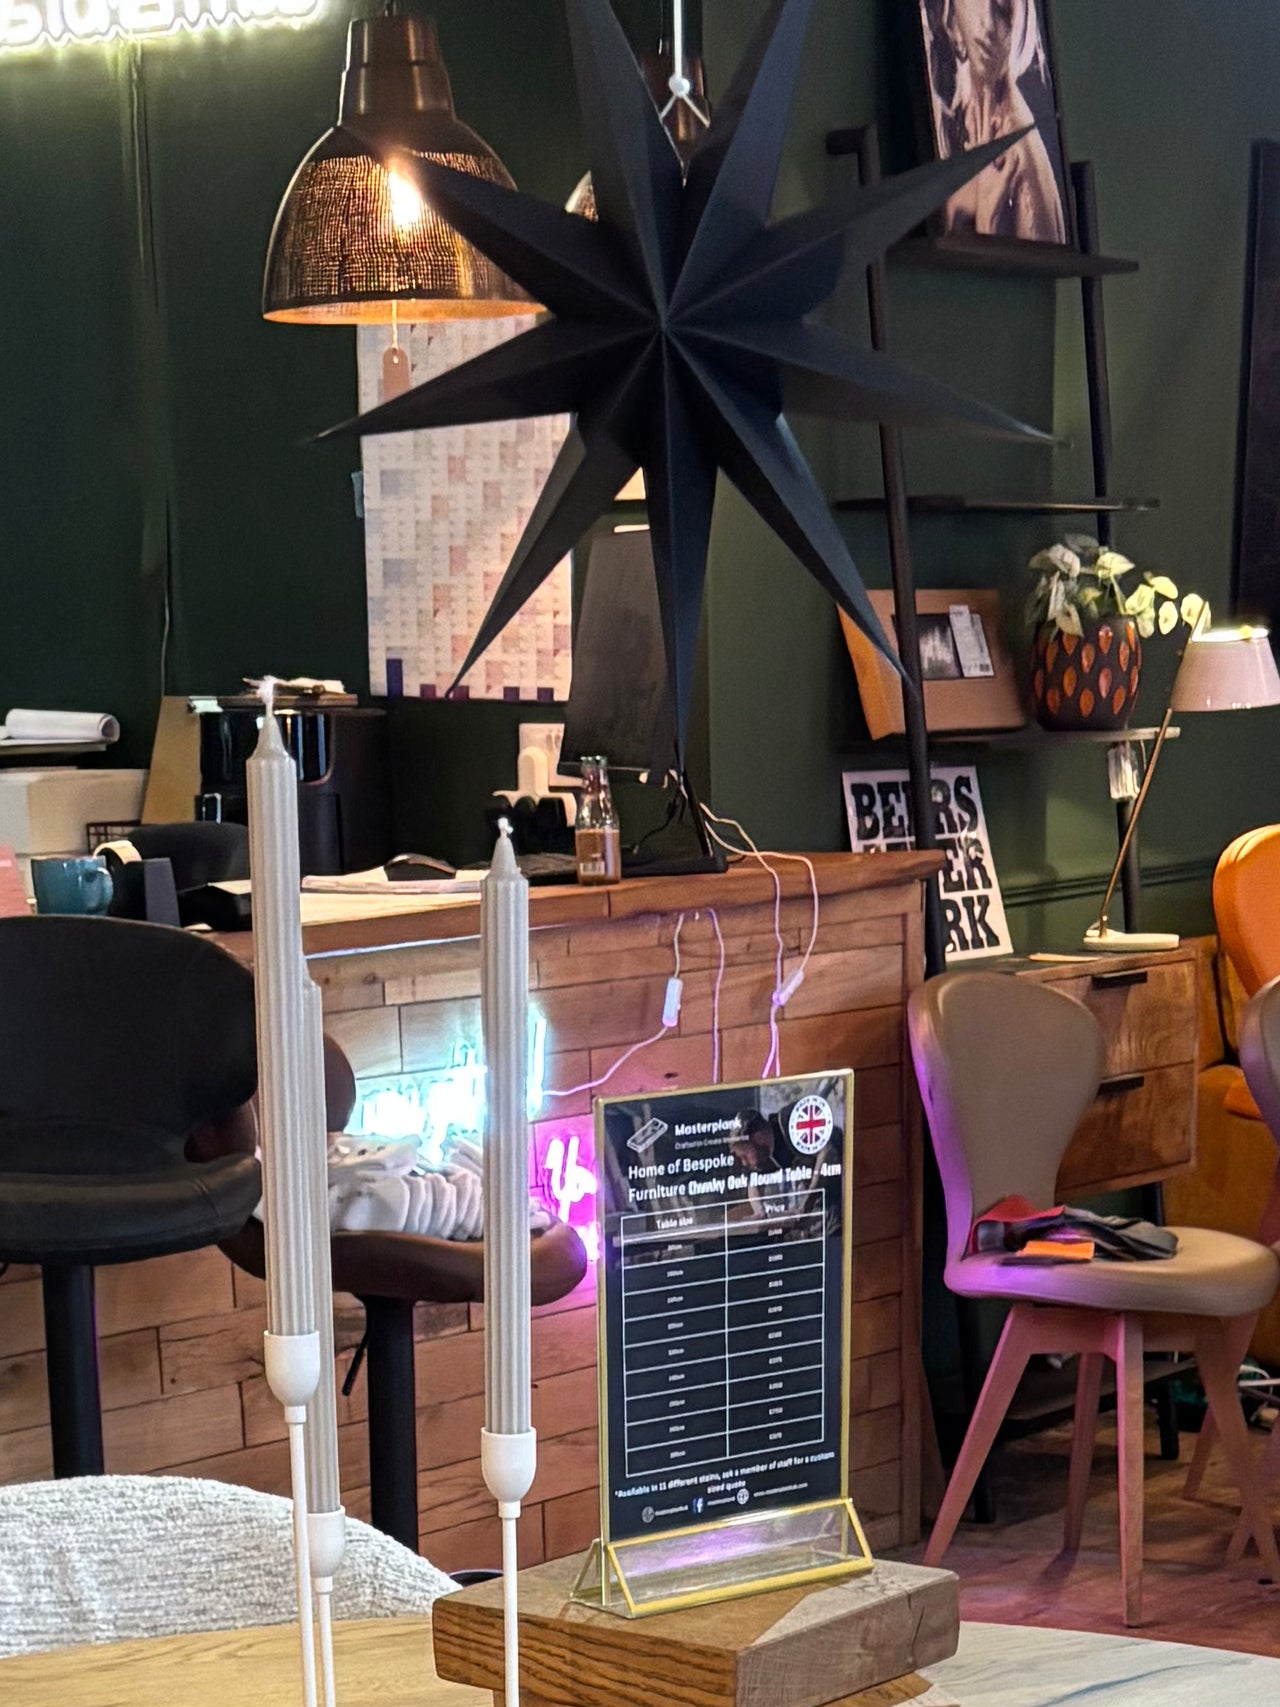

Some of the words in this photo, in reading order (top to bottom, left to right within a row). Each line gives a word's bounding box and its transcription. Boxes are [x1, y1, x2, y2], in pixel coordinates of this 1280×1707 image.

[675, 1117, 742, 1136] Masterplank
[628, 1164, 665, 1180] Home
[667, 1158, 681, 1175] of
[683, 1153, 734, 1173] Bespoke
[628, 1184, 686, 1202] Furniture
[688, 1177, 725, 1195] Chunky
[727, 1174, 748, 1190] Oak
[749, 1168, 783, 1187] Round
[785, 1165, 812, 1181] Table
[820, 1163, 841, 1177] 4cm
[765, 1203, 785, 1213] Price
[656, 1219, 677, 1229] Table
[668, 1476, 698, 1489] different
[722, 1469, 733, 1479] ask
[740, 1464, 768, 1475] member
[769, 1460, 777, 1470] of
[777, 1458, 793, 1468] staff
[794, 1456, 804, 1465] for
